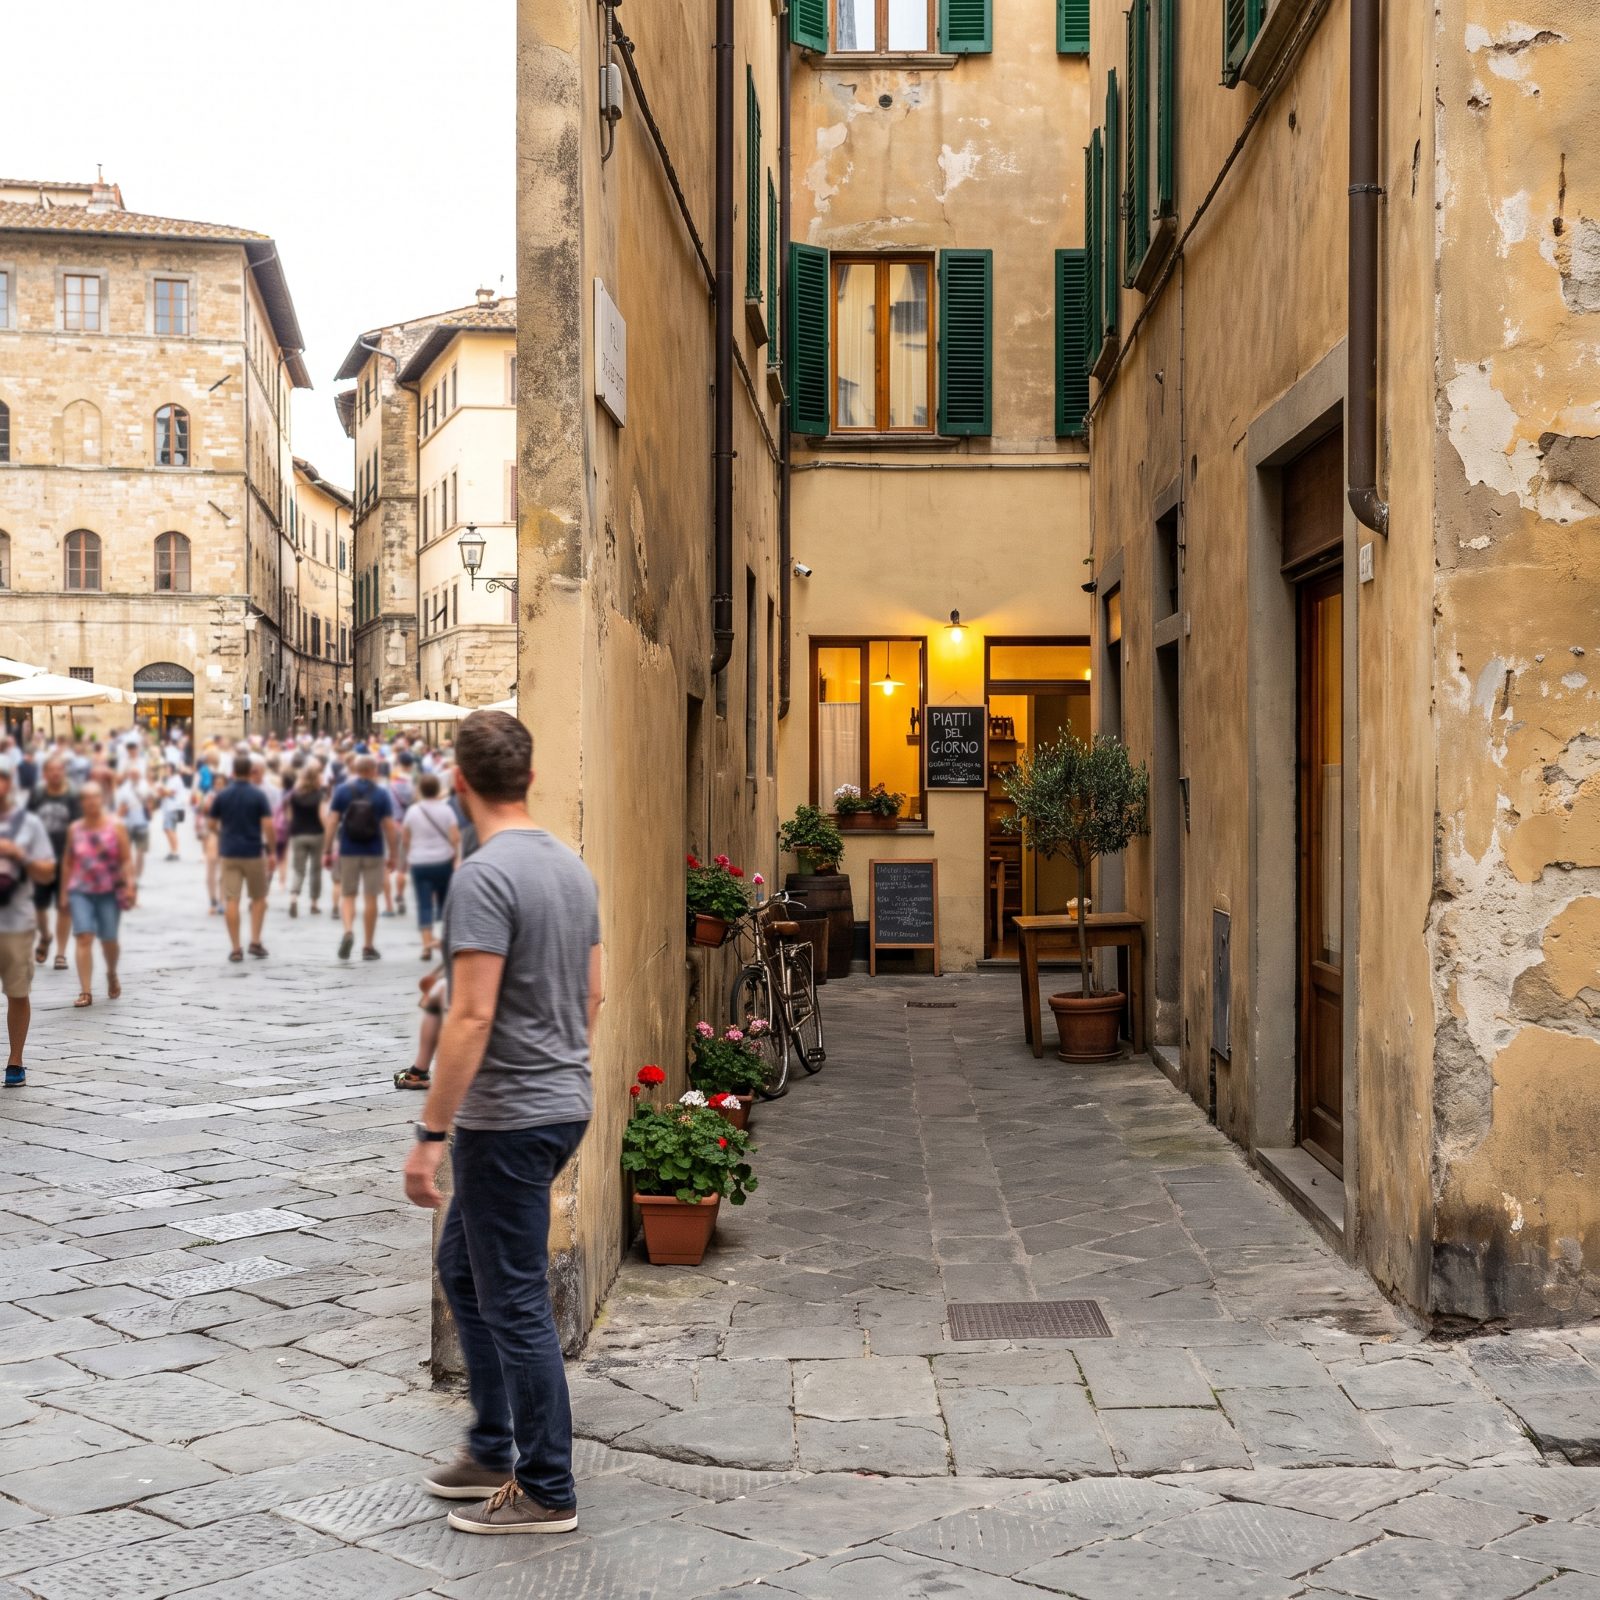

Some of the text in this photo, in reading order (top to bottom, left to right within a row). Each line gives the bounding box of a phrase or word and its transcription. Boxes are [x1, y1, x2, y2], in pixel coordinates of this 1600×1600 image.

[933, 712, 971, 726] PIATTI
[945, 728, 963, 739] DEL
[931, 741, 979, 754] GIORNO
